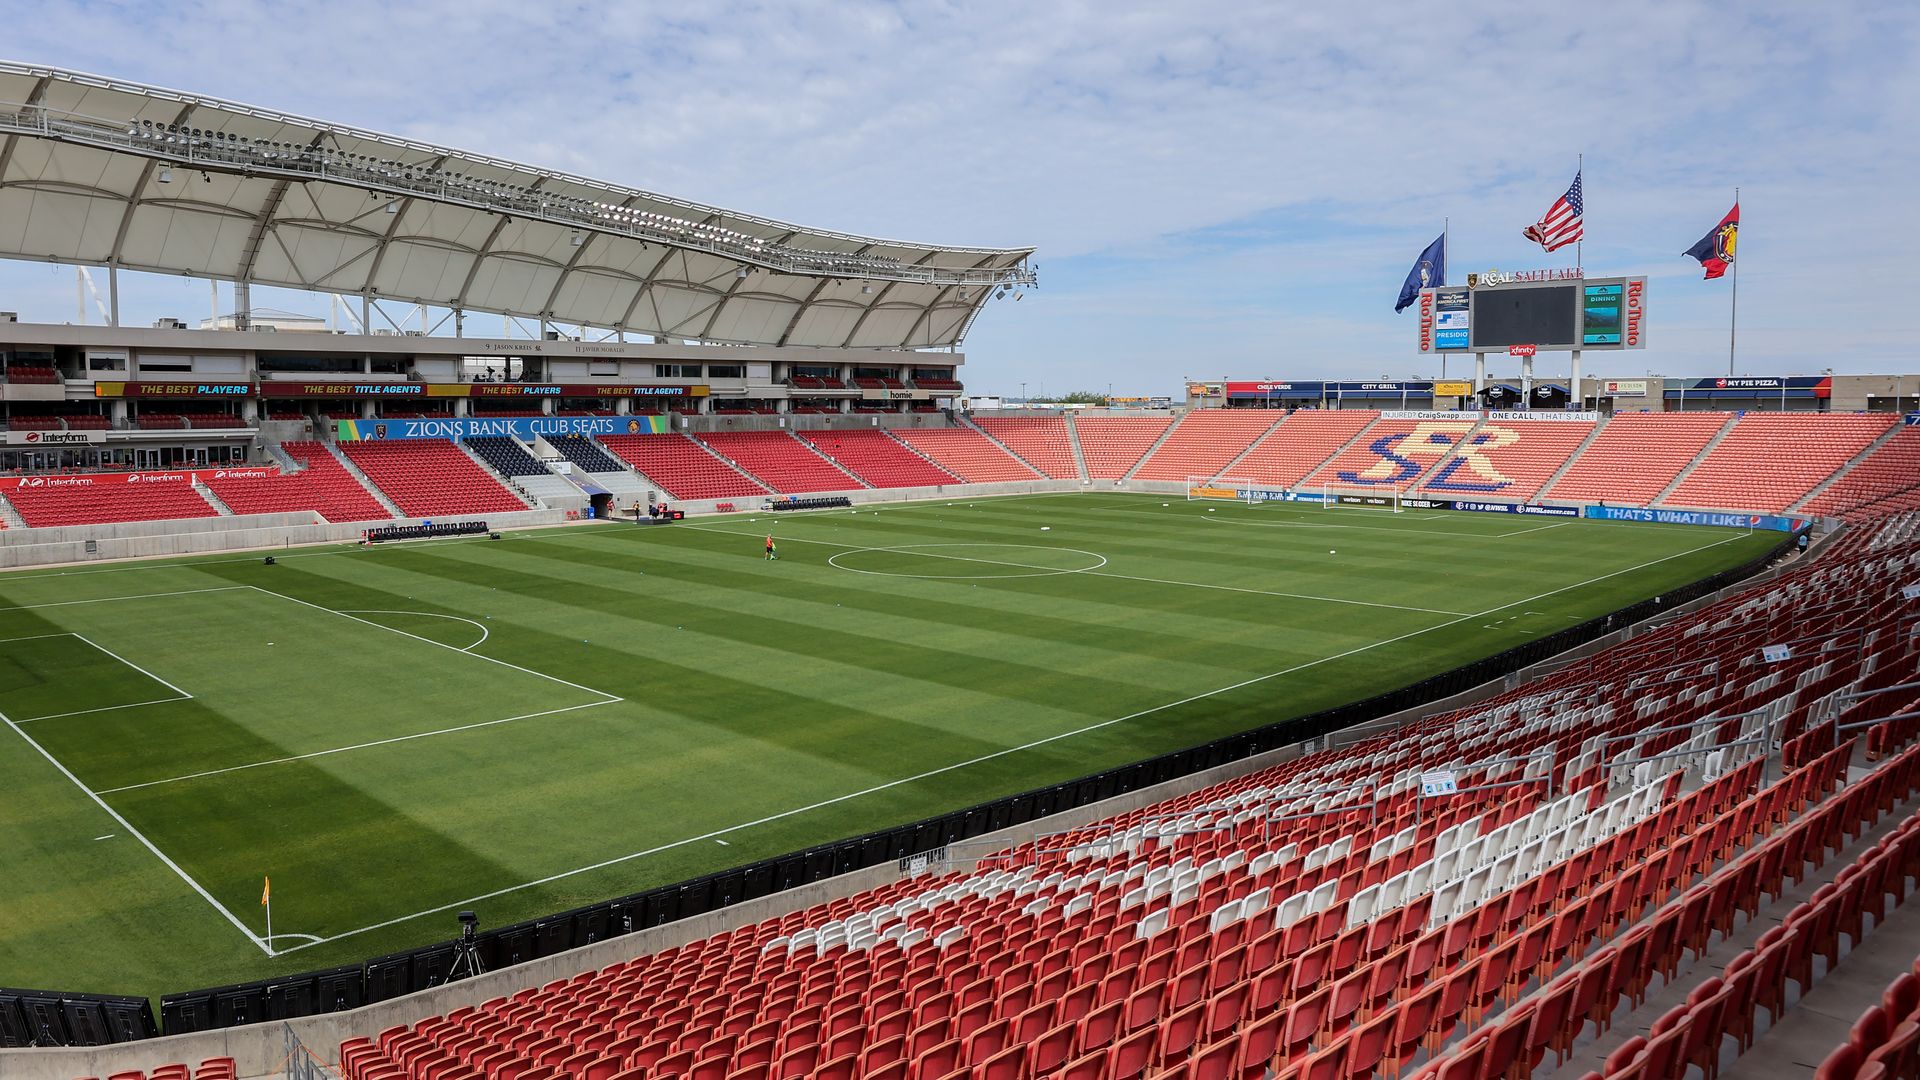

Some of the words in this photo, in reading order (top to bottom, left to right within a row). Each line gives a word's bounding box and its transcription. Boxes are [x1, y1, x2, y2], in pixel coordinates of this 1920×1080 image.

[1511, 346, 1534, 355] xfinity
[140, 385, 163, 394] THE
[165, 385, 196, 394] BEST
[197, 385, 248, 394] PLAYERS
[304, 385, 323, 394] THE
[326, 385, 352, 394] BEST
[355, 385, 381, 394] TITLE
[382, 385, 421, 394] AGENTS
[482, 387, 499, 395] THE
[500, 387, 523, 395] BEST
[523, 387, 561, 395] PLAYERS
[597, 387, 612, 395] THE
[613, 387, 632, 395] BEST
[633, 387, 654, 395] TITLE
[654, 387, 683, 395] AGENTS
[890, 390, 913, 399] homie
[1417, 412, 1477, 420] CraigSwapp.com
[1512, 412, 1537, 420] CALL,
[405, 420, 463, 437] ZIONS
[530, 420, 568, 434] CLUB
[572, 419, 614, 434] SEATS
[42, 432, 88, 443] Interform
[142, 472, 183, 483] Interform
[227, 470, 266, 479] Interform
[47, 477, 93, 487] Interform
[1413, 500, 1431, 508] SOCCER
[1484, 503, 1508, 512] @NWSL
[1605, 508, 1653, 521] THAT'S
[1657, 511, 1699, 523] WHAT
[1702, 513, 1707, 524] I
[1712, 515, 1745, 527] LIKE
